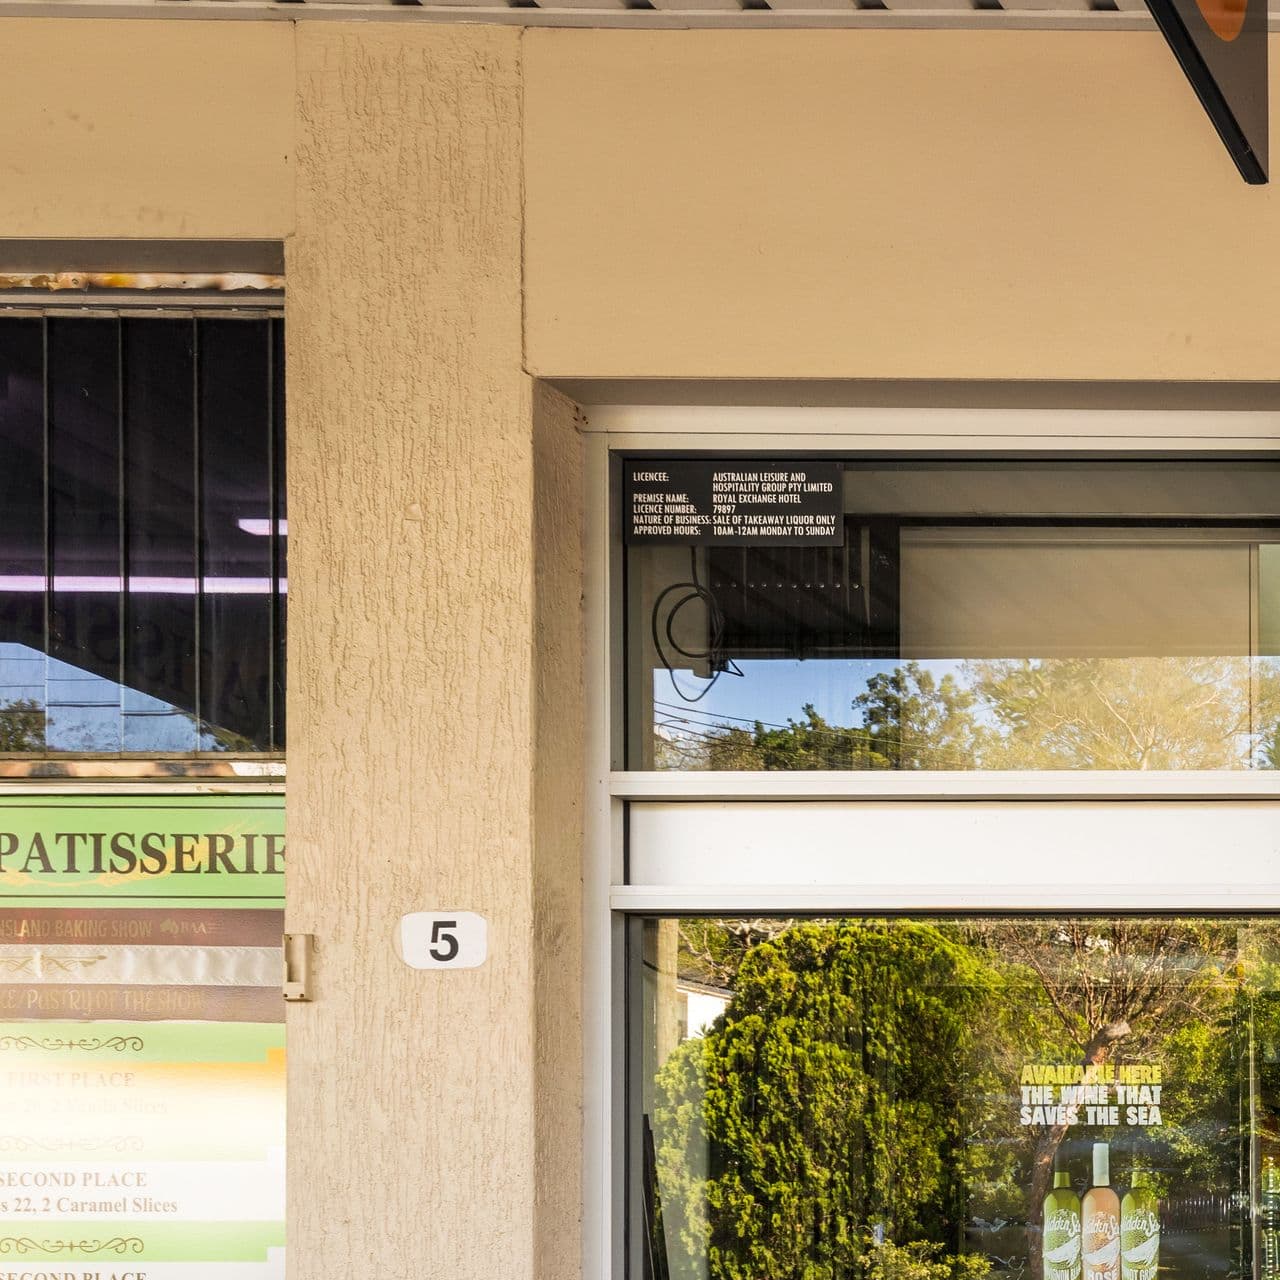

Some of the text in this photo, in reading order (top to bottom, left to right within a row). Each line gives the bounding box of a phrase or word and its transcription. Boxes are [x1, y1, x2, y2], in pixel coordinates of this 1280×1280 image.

[634, 473, 669, 482] LICENCEE:
[713, 473, 806, 482] AUSTRALIAN LEISURE AND
[713, 483, 832, 492] HOSPITALITY GROUP PTY LIMITED
[634, 494, 689, 503] PREMISE NAME:
[713, 495, 801, 504] ROYAL EXCHANGE HOTEL
[634, 505, 697, 514] LICENCE NUMBER:
[713, 505, 736, 514] 79897
[634, 515, 711, 524] NATURE OF BUSINESS:
[713, 516, 835, 525] SALE OF TAKEAWAY LIQUOR ONLY
[634, 526, 701, 535] APPROVED HOURS:
[760, 527, 792, 535] MONDAY
[794, 527, 804, 535] TO
[806, 527, 835, 535] SUNDAY
[55, 920, 152, 937] BAKING SHOW
[429, 920, 459, 962] 5
[71, 1072, 136, 1087] PLACE
[1020, 1065, 1162, 1085] AVAILABLE HERE
[1020, 1086, 1162, 1105] THE WINE THAT
[1020, 1106, 1162, 1126] SAVES THE SEA
[83, 1172, 147, 1187] PLACE
[14, 1198, 177, 1215] 22, 2 Caramel Slices
